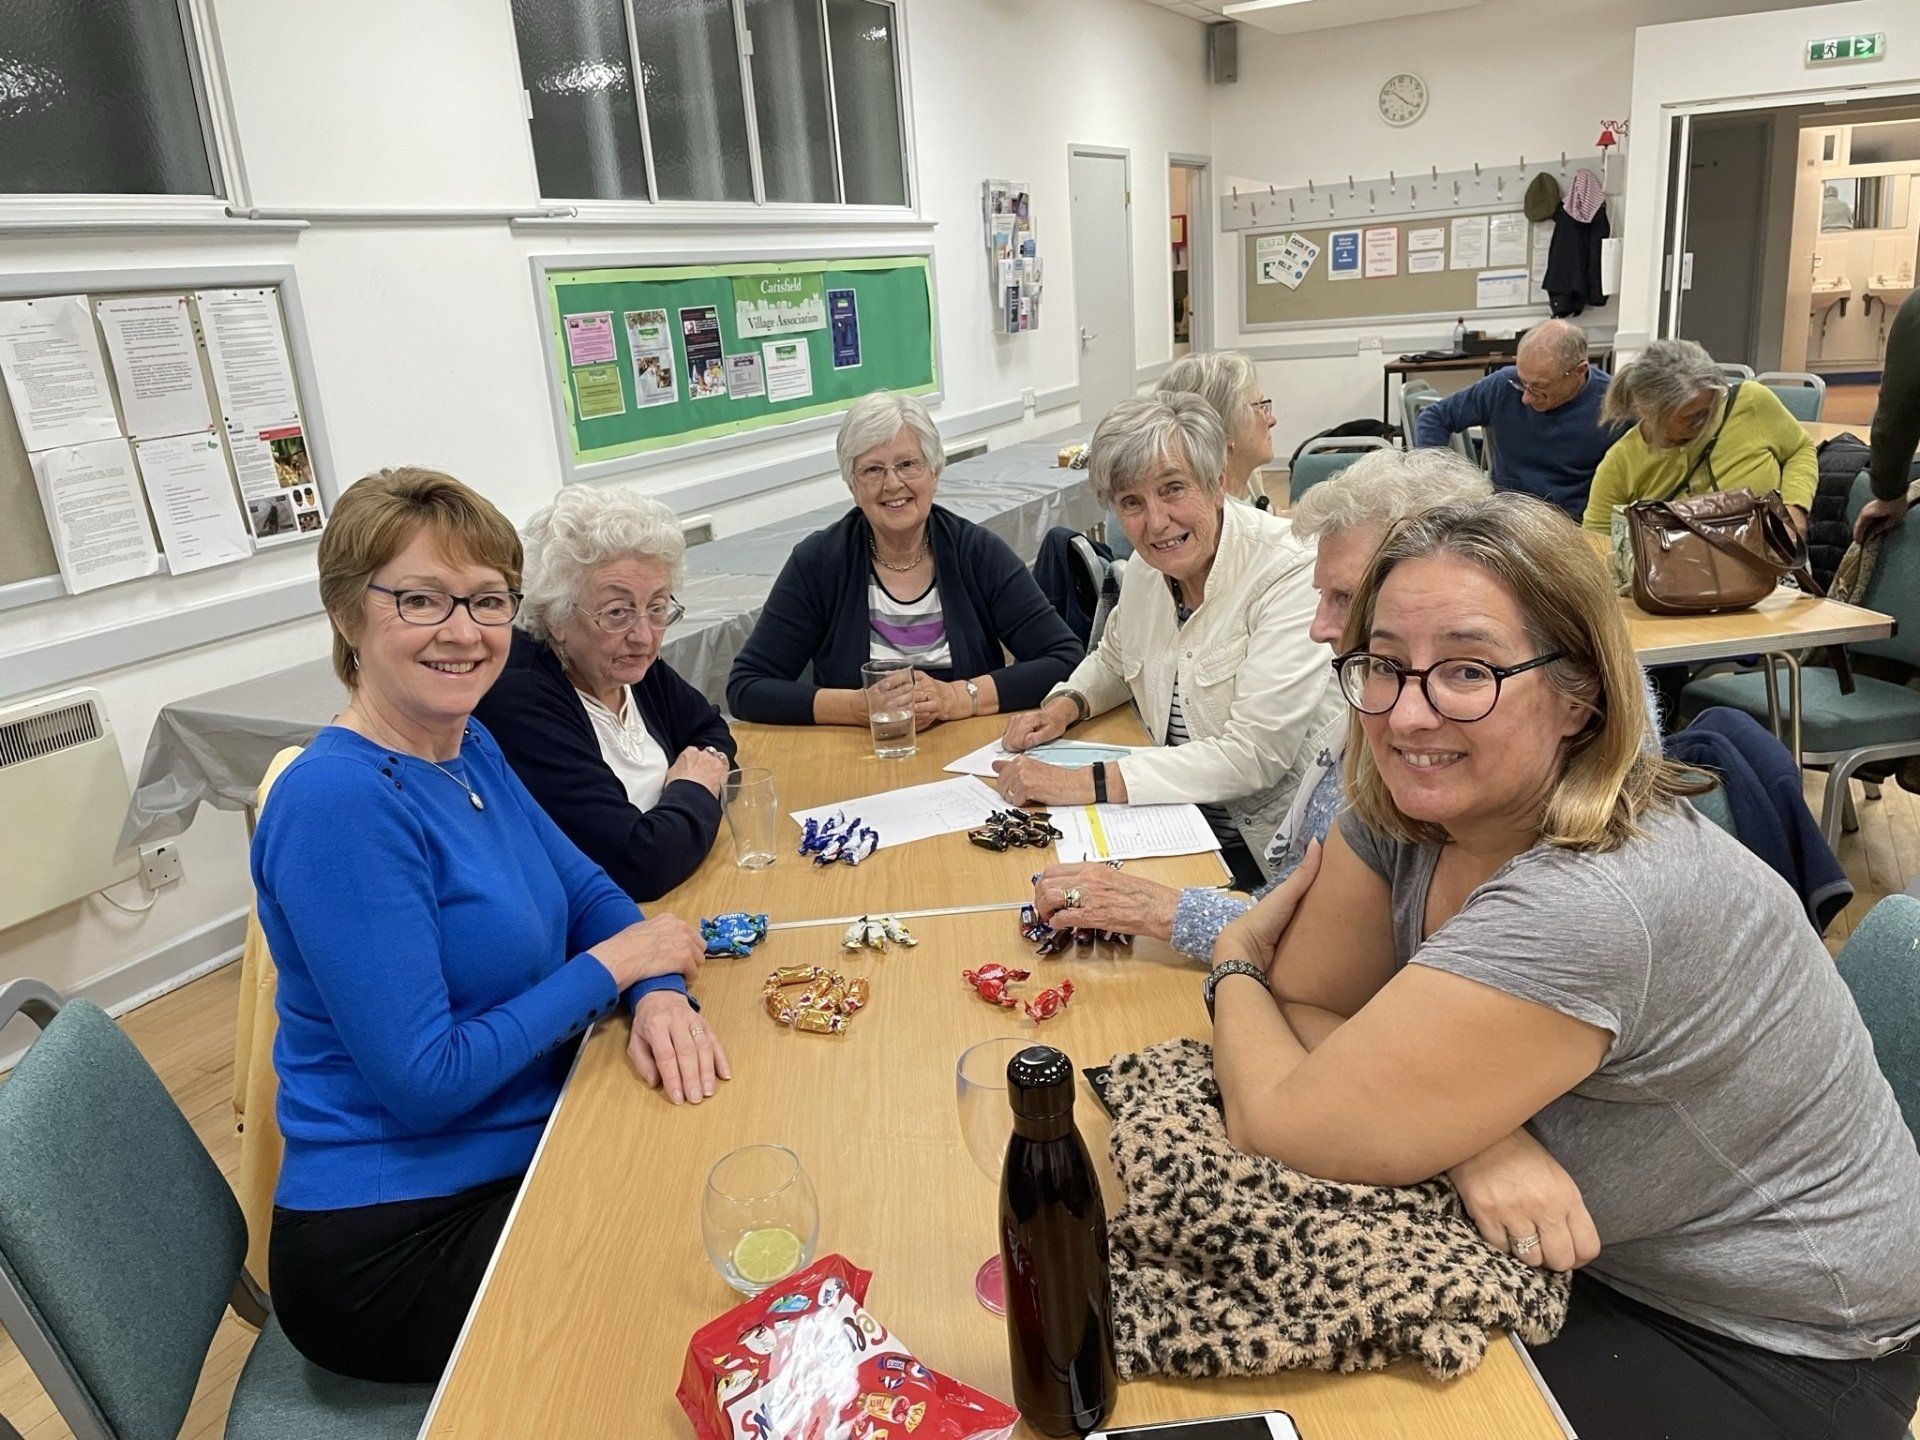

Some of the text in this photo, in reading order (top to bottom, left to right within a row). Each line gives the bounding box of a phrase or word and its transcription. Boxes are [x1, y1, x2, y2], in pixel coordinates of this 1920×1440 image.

[760, 277, 801, 294] Catisfield
[748, 312, 818, 331] Village Association
